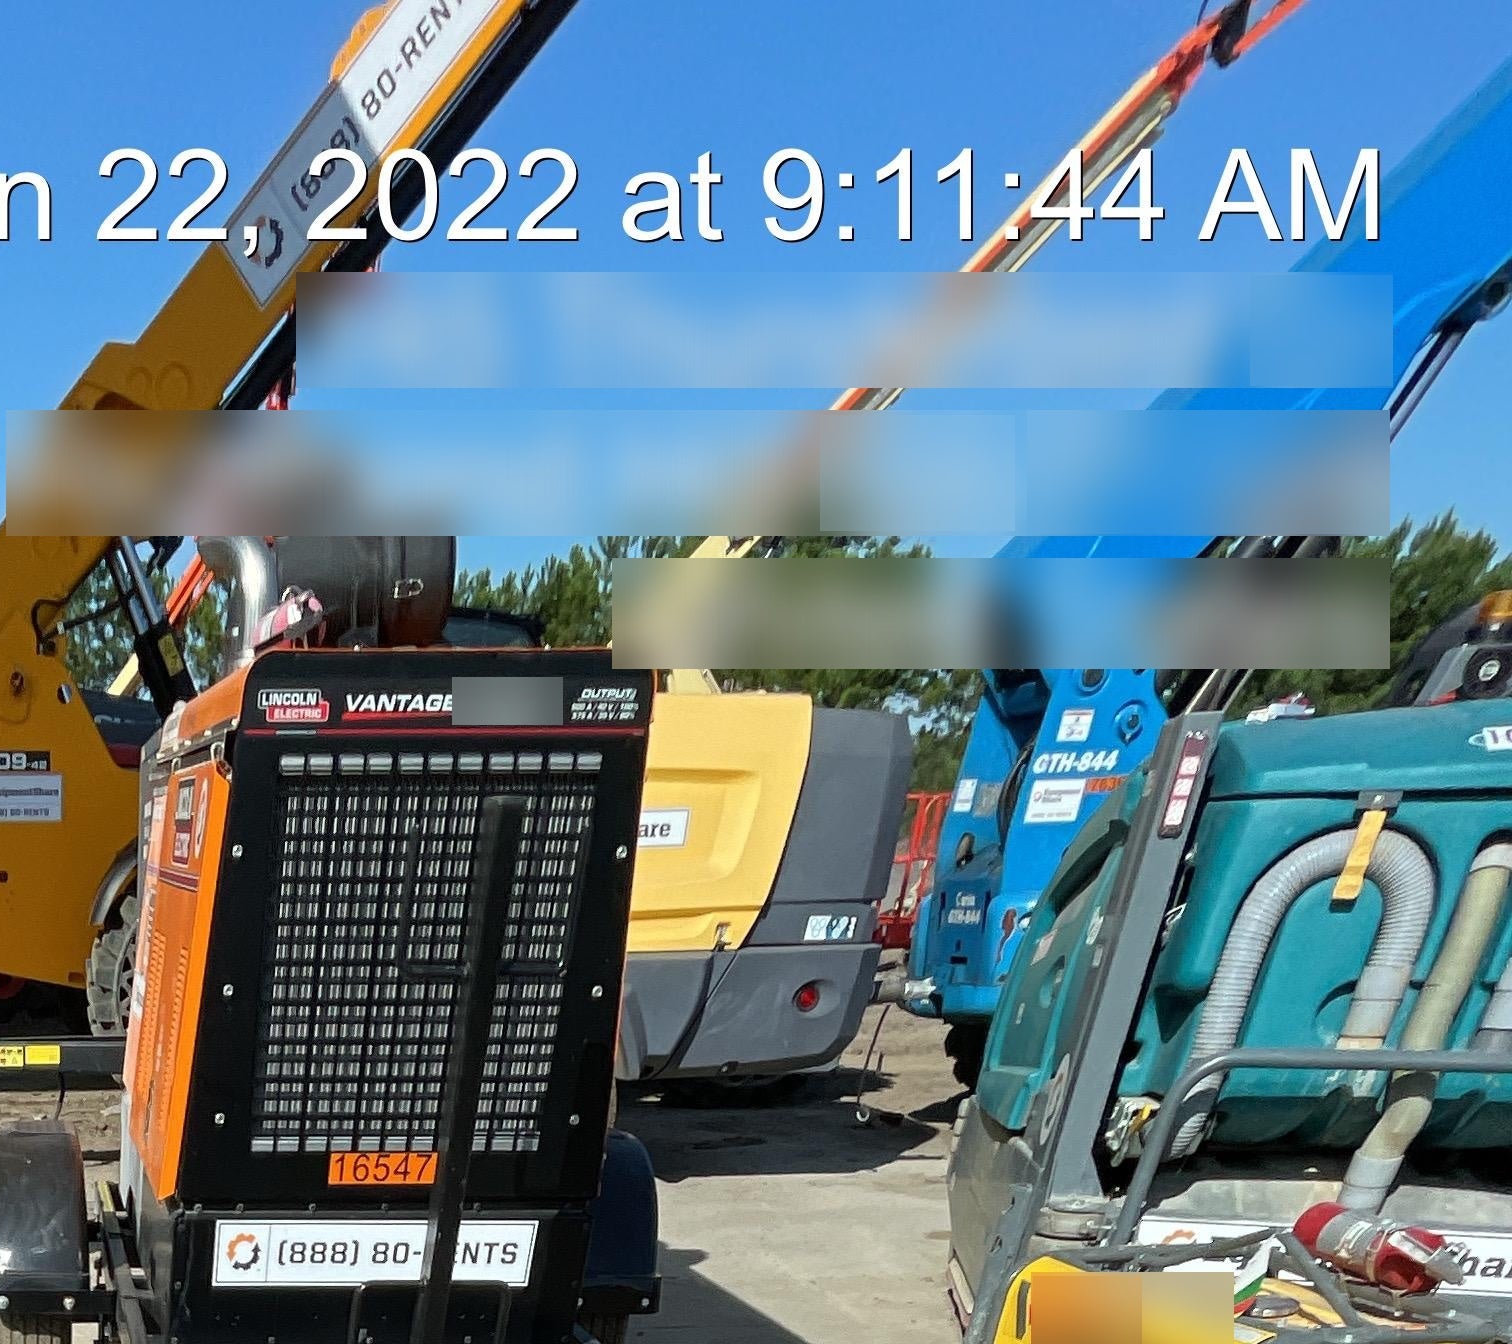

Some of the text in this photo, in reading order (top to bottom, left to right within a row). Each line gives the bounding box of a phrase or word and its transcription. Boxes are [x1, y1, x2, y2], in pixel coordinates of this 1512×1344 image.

[360, 0, 463, 120] 80-REN
[261, 692, 317, 706] LINCOLN
[345, 693, 452, 712] VANTAGE
[273, 707, 322, 719] ELECTRIC
[334, 1153, 433, 1183] 16547
[278, 1239, 519, 1266] (888) 80-NTS
